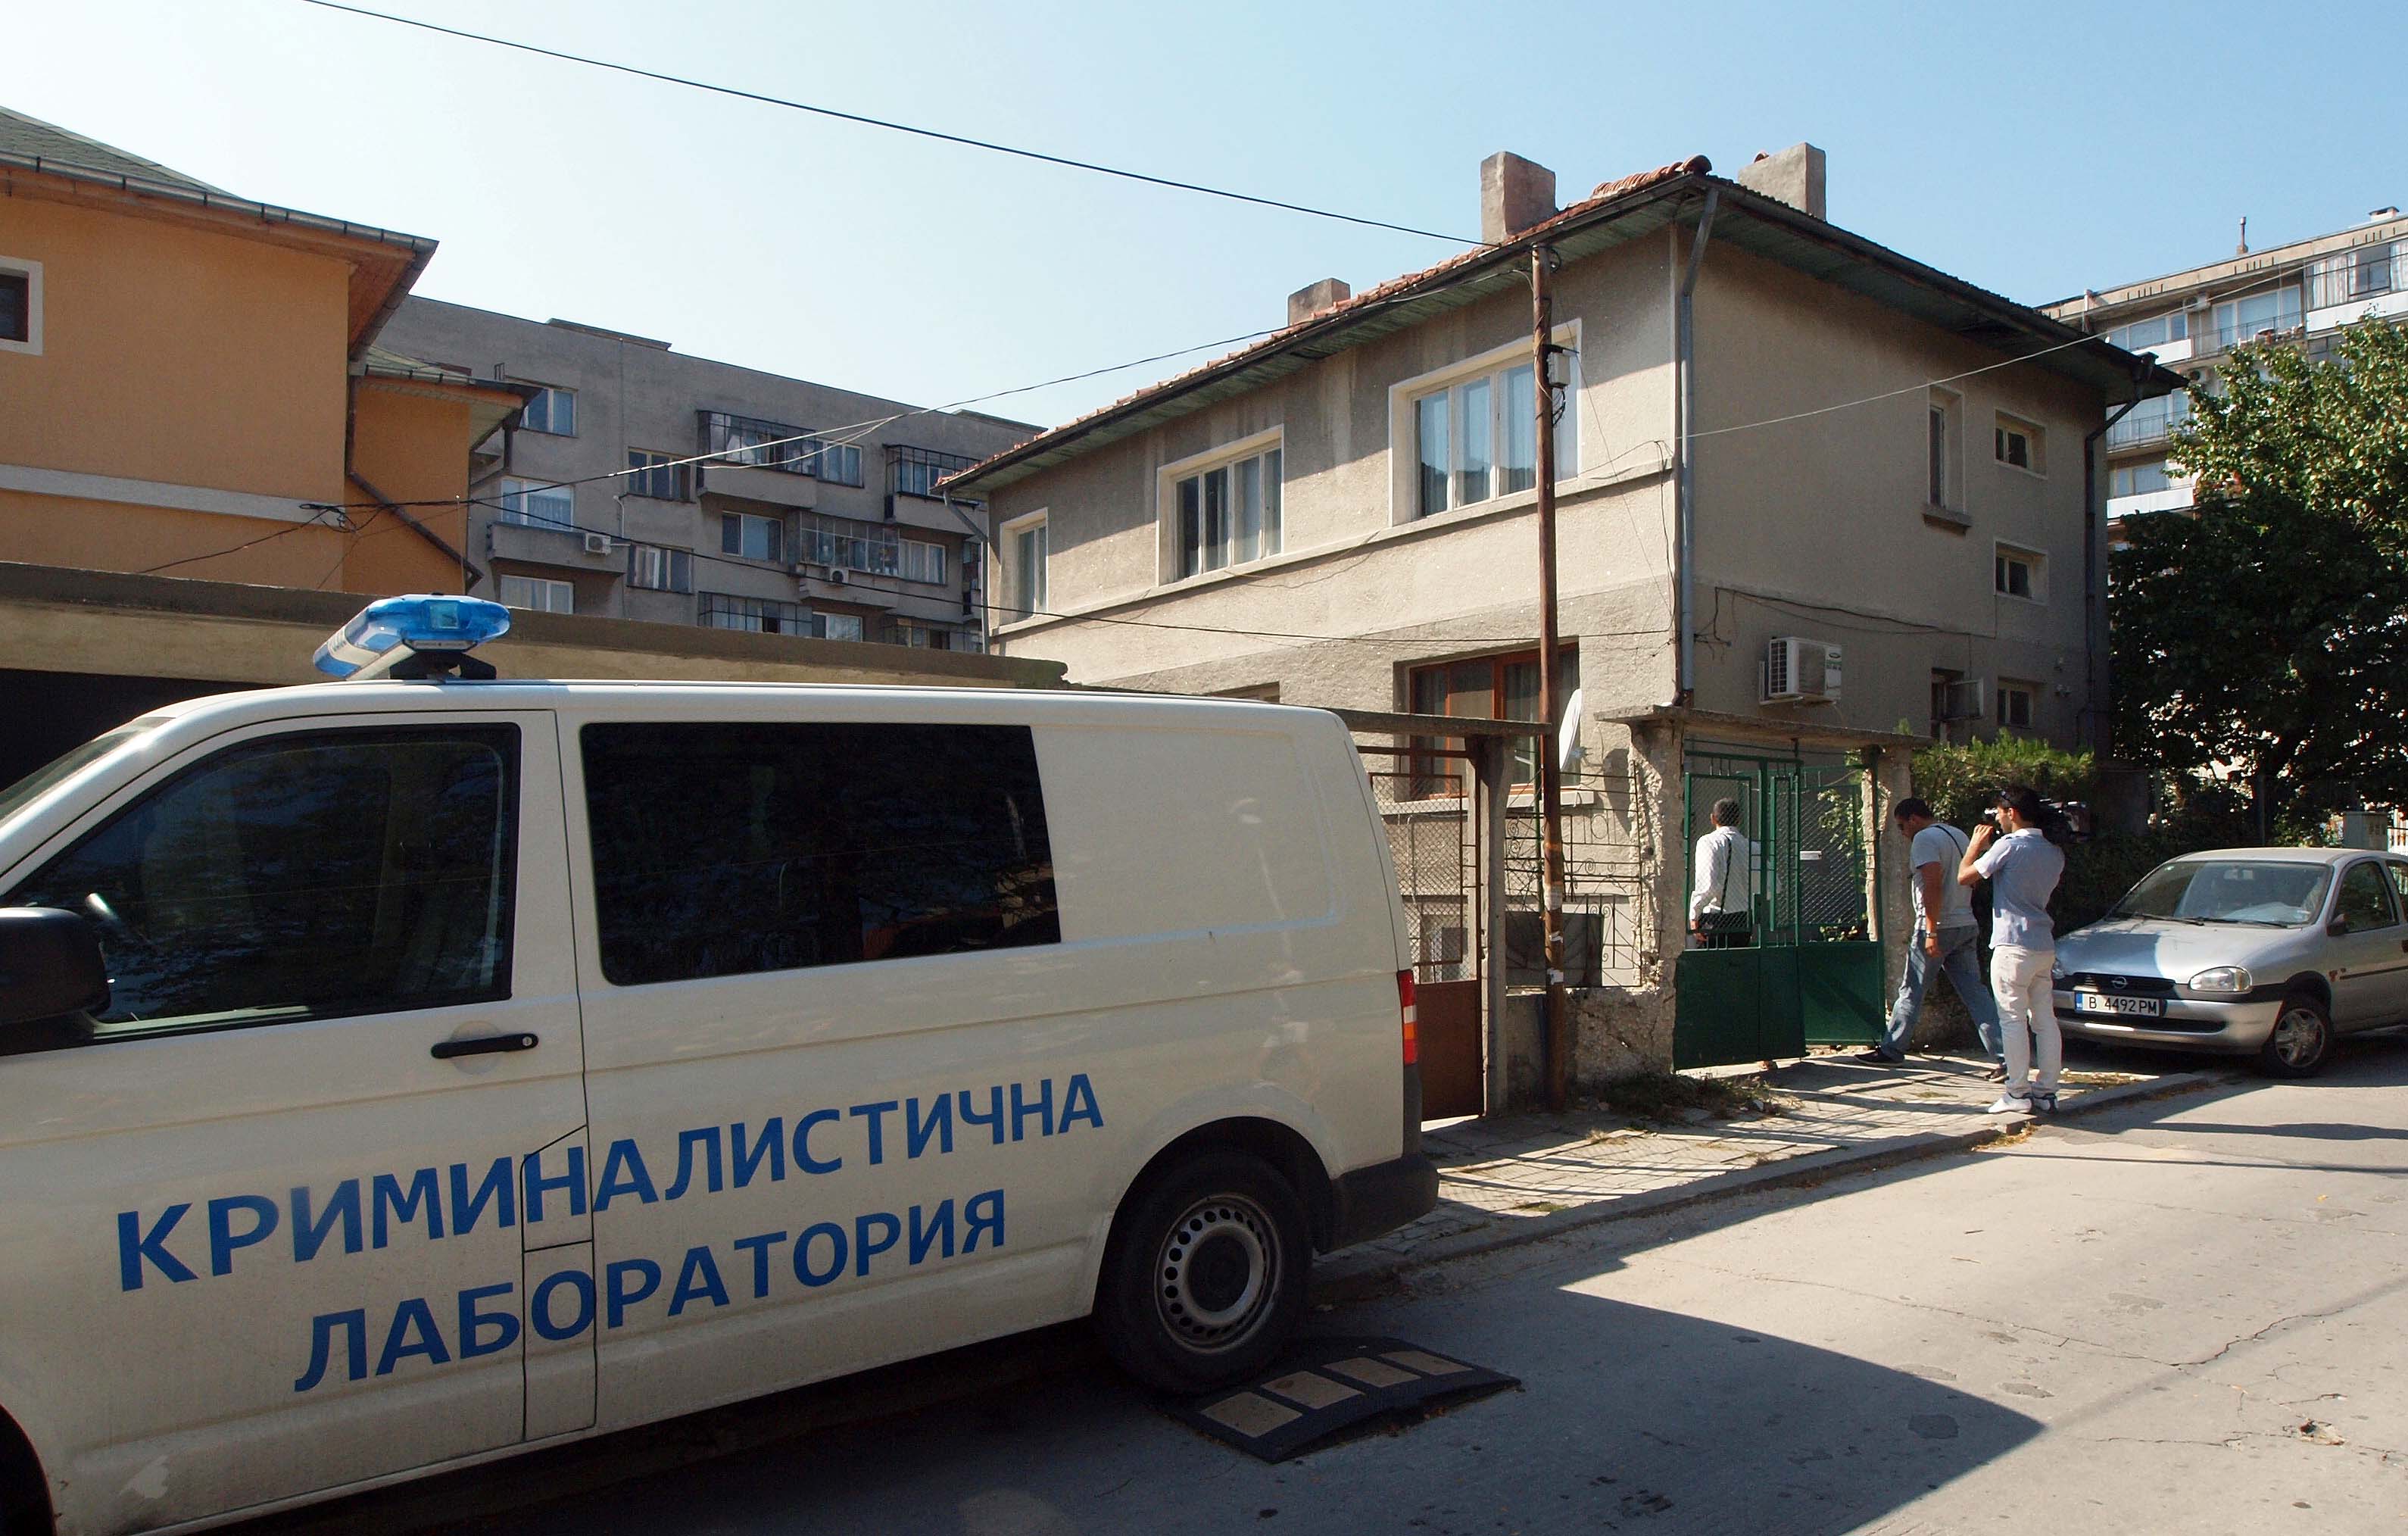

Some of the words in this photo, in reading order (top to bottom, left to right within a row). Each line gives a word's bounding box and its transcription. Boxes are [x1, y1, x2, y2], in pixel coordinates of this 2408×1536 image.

[2088, 997, 2097, 1009] B
[2104, 997, 2135, 1013] 4492
[2138, 1001, 2157, 1013] PM
[117, 1073, 1104, 1291] КРИМИНАЛИСТИЧНА
[295, 1188, 1005, 1392] ЛАБОРАТОРИЯ
